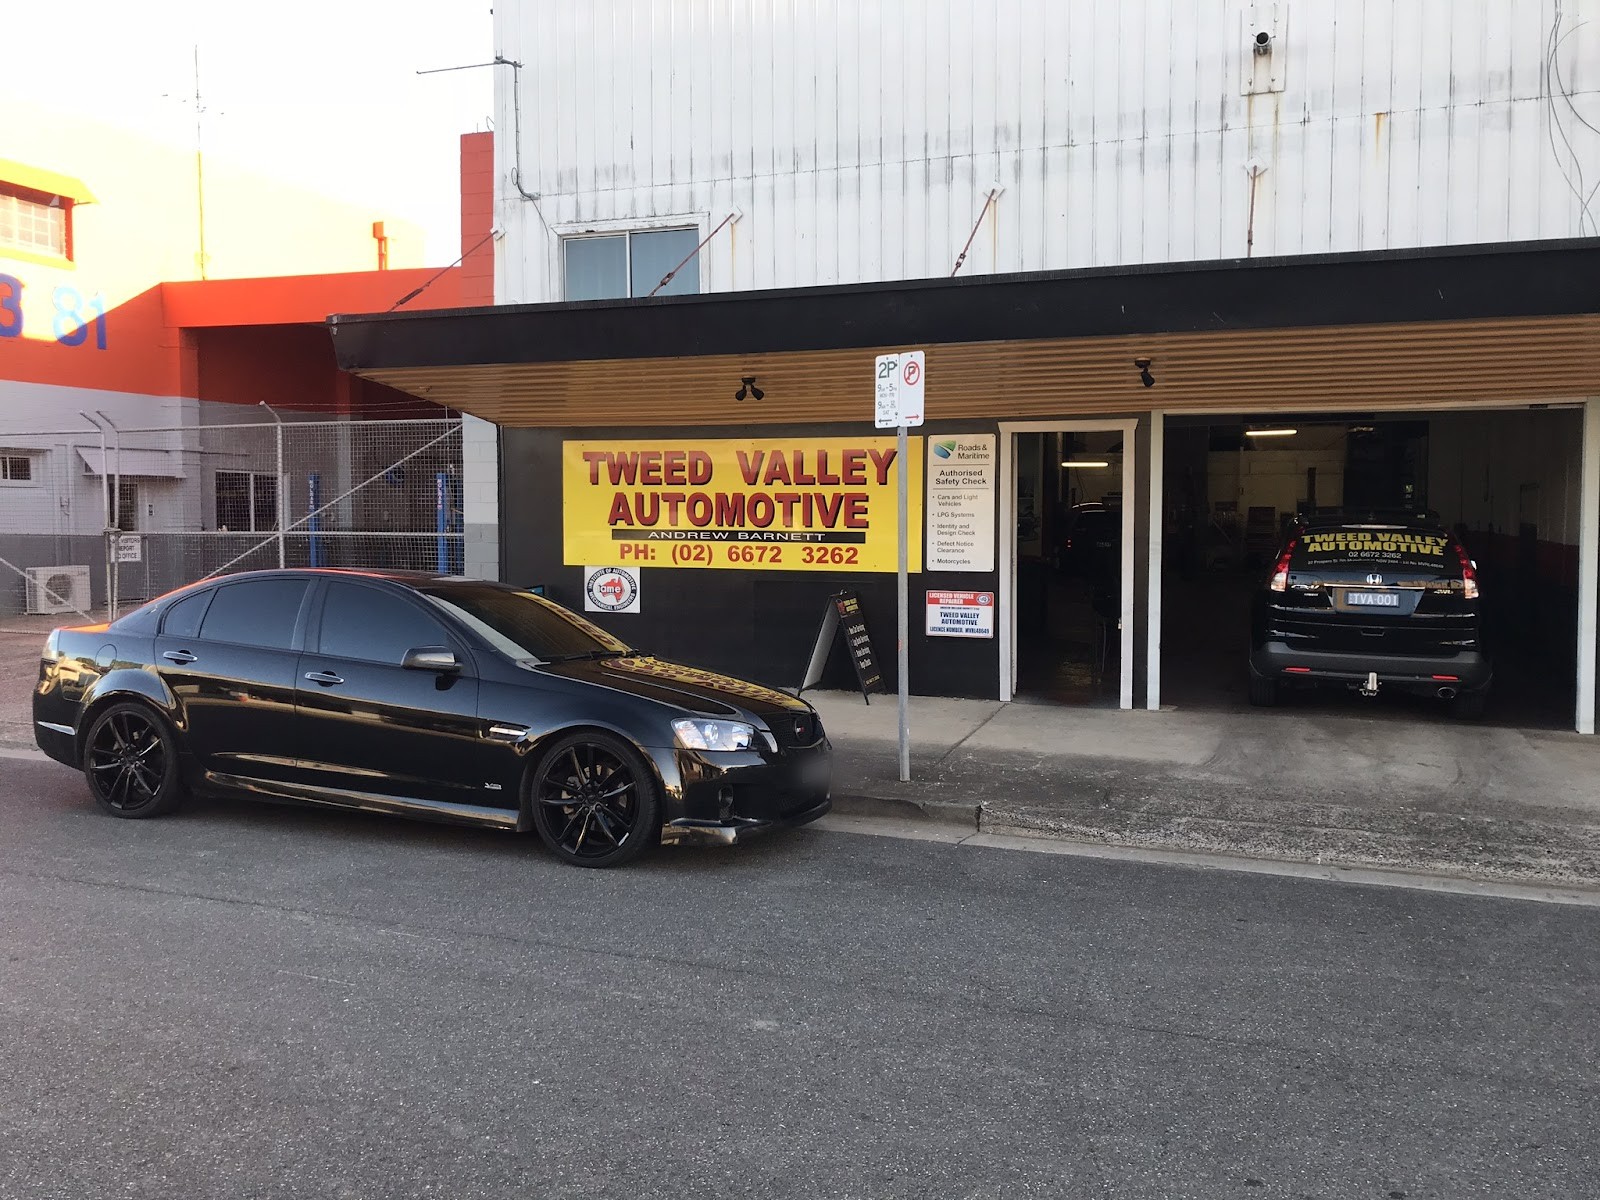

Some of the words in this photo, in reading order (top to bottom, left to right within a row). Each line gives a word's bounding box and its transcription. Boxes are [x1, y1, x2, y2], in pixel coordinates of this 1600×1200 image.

[52, 286, 107, 350] 81
[878, 361, 896, 378] 2P
[958, 452, 990, 460] Maritime
[582, 450, 713, 486] TWEED
[736, 448, 898, 486] VALLEY
[939, 469, 983, 477] Authorised
[936, 478, 960, 486] Safety
[608, 492, 870, 528] AUTOMOTIVE
[648, 531, 729, 540] ANDREW
[738, 532, 826, 542] BARNETT
[1301, 532, 1372, 544] TWEED
[1376, 533, 1448, 547] VALLEY
[620, 544, 656, 560] PH:
[672, 544, 713, 566] (02)
[727, 545, 782, 564] 6672
[802, 546, 859, 564] 3262
[1308, 541, 1444, 556] AUTOMOTIVE
